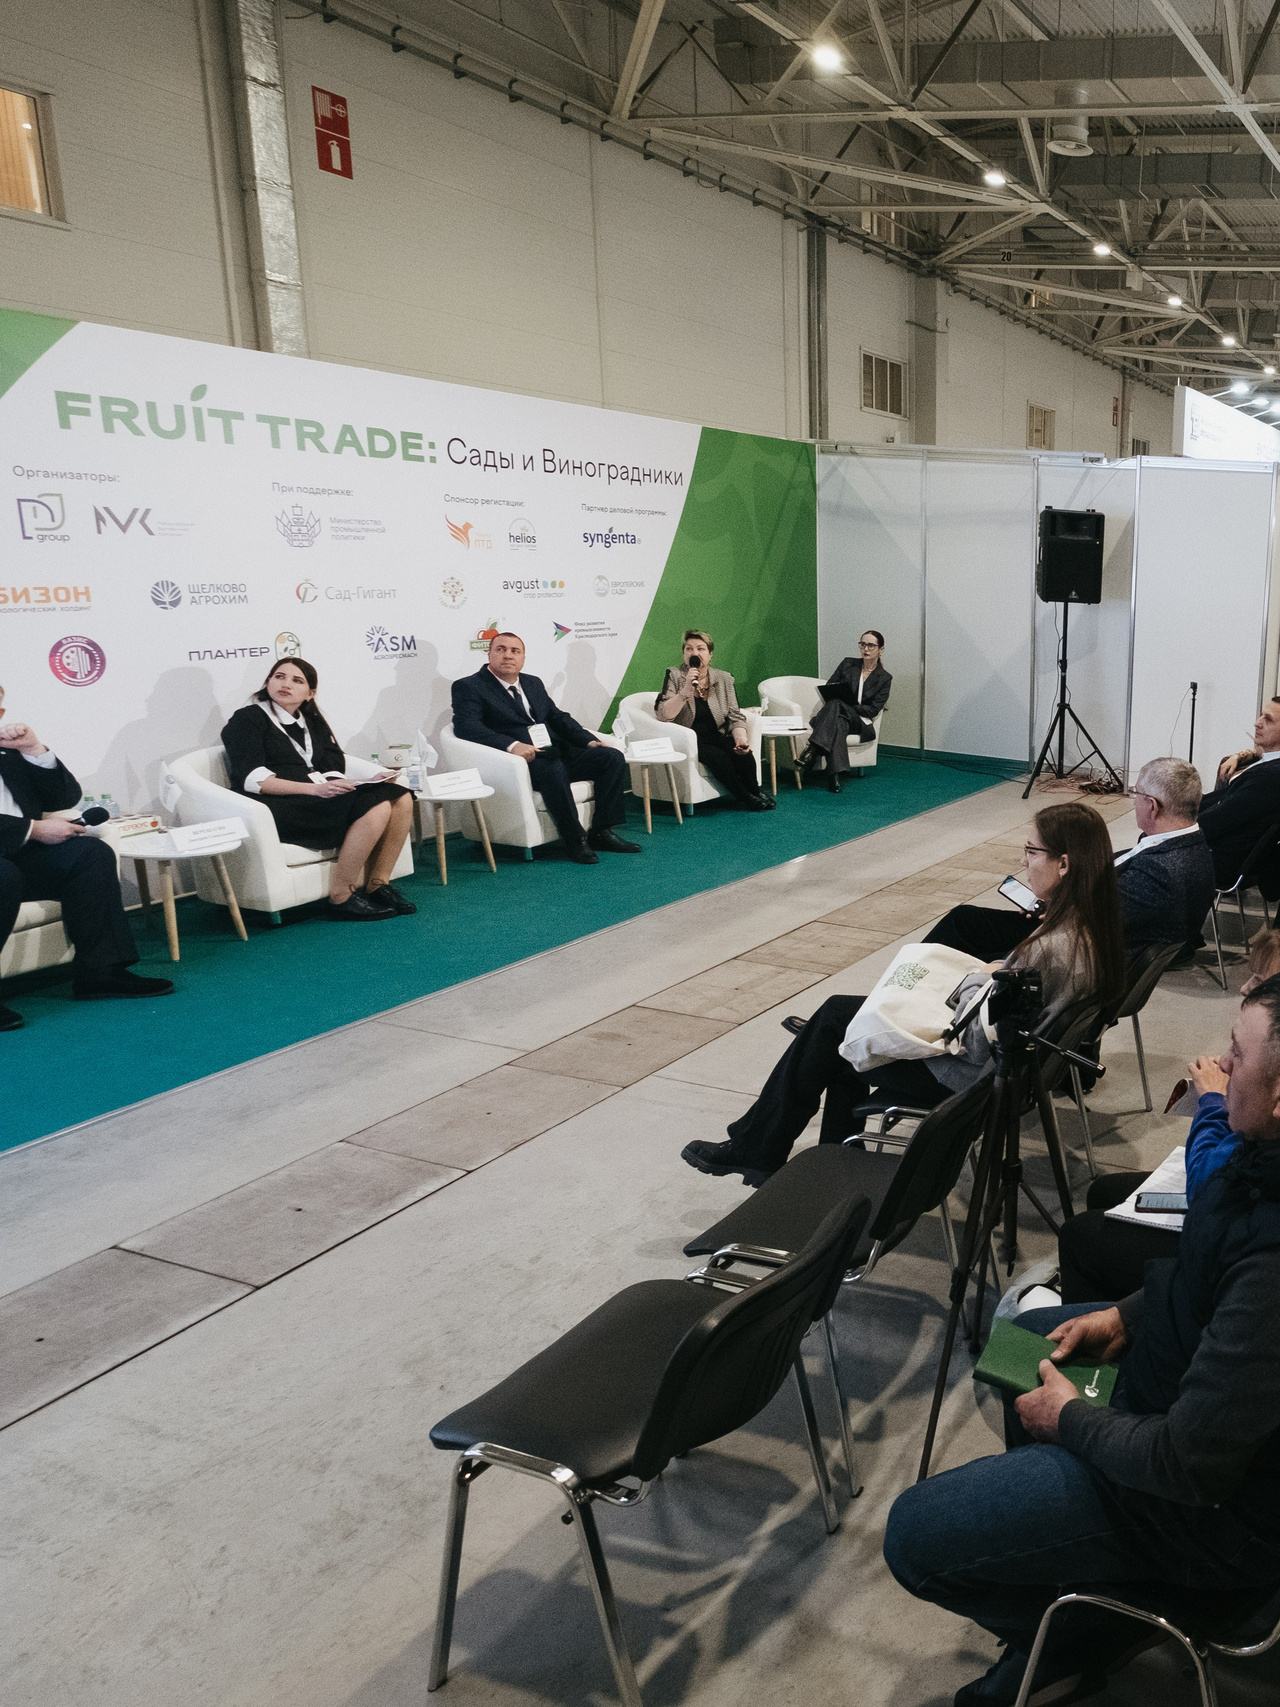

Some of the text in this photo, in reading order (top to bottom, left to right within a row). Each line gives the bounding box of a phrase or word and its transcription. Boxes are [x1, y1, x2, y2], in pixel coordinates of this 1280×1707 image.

[1001, 251, 1012, 262] 20
[54, 384, 437, 464] FRUIT TRADE:
[447, 437, 684, 487] Сады и Виноградники
[12, 465, 121, 485] Организаторы:
[272, 482, 354, 498] При поддержке:
[444, 493, 479, 506] Спонсор
[581, 503, 608, 513] Партнер
[37, 533, 70, 543] group
[508, 532, 537, 544] helios
[187, 583, 247, 594] ЩЕЛКОВО
[502, 578, 540, 593] avgust
[190, 594, 249, 606] АГРОХИМ
[325, 586, 398, 602] Сад-Гигант
[374, 635, 417, 653] ASM
[188, 646, 270, 661] ПЛАНТЕР
